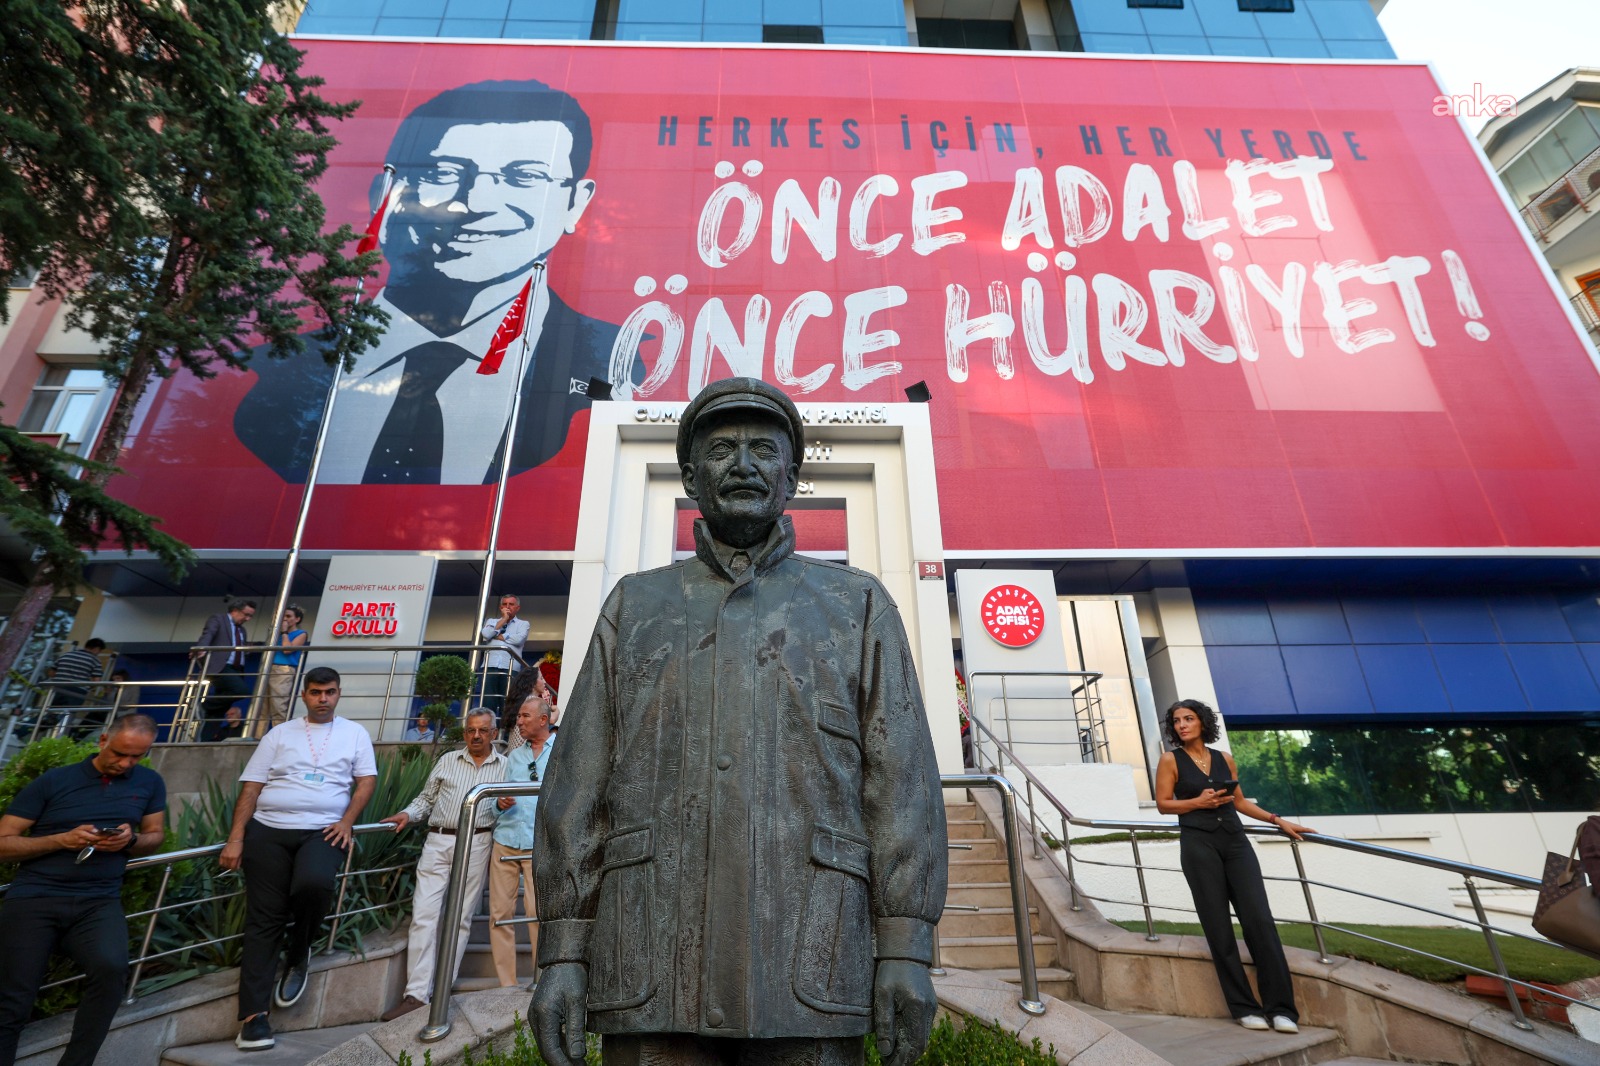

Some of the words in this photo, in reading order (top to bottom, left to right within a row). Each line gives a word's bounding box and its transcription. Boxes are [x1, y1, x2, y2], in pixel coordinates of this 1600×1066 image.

[657, 115, 862, 150] HERKES
[899, 114, 1044, 160] İÇİN,
[1078, 125, 1174, 158] HER
[1203, 127, 1368, 162] YERDE
[696, 159, 969, 269] ÖNCE
[1001, 155, 1335, 252] ADALET
[607, 273, 909, 402] ÖNCE
[817, 405, 888, 424] PARTİSİ
[804, 440, 833, 461] VİT
[925, 564, 937, 574] 38
[328, 583, 376, 592] CUMHURİYET
[377, 584, 396, 592] HALK
[397, 583, 425, 592] PARTİSİ
[340, 602, 396, 618] PARTİ
[996, 605, 1029, 616] ADAY
[331, 619, 398, 636] OKULU
[996, 615, 1030, 626] OFİSİ
